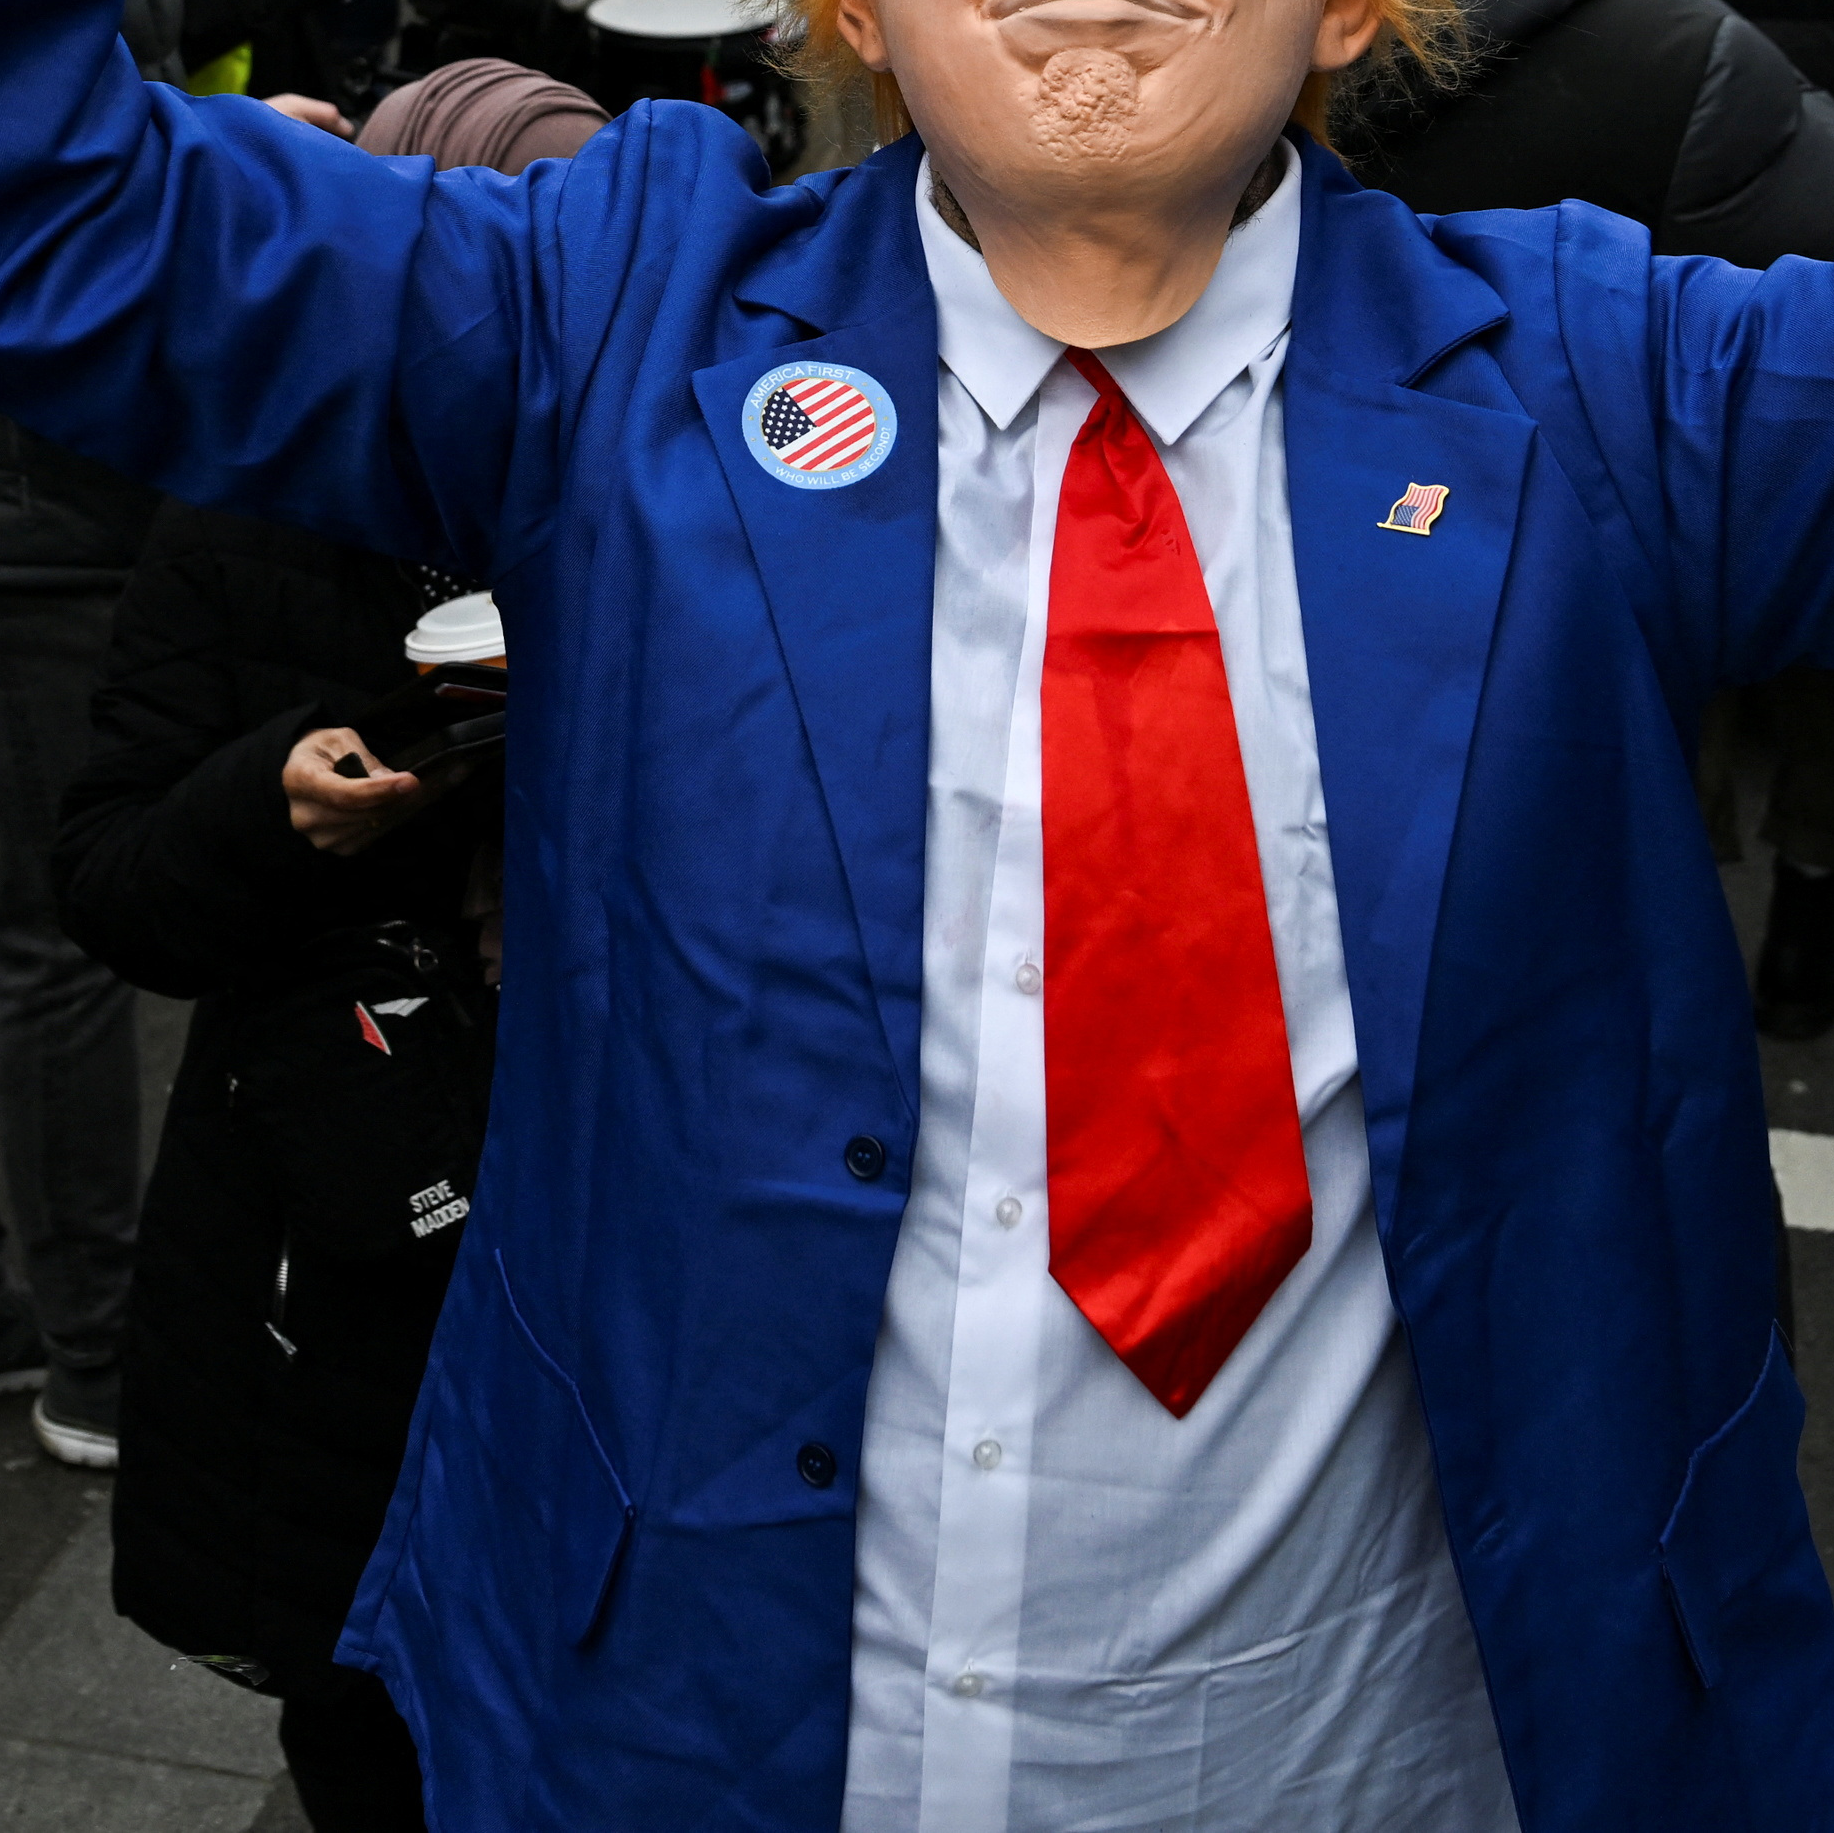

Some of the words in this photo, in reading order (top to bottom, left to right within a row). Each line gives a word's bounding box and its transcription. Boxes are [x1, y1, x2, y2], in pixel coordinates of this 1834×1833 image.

[750, 366, 805, 409] AMERICA
[808, 365, 856, 380] FIRST
[774, 466, 804, 484] WHO
[807, 476, 840, 485] WILL
[841, 468, 859, 481] BE
[857, 426, 892, 473] SECOND?
[408, 1178, 455, 1213] STEVE
[410, 1196, 470, 1239] MADDEN
